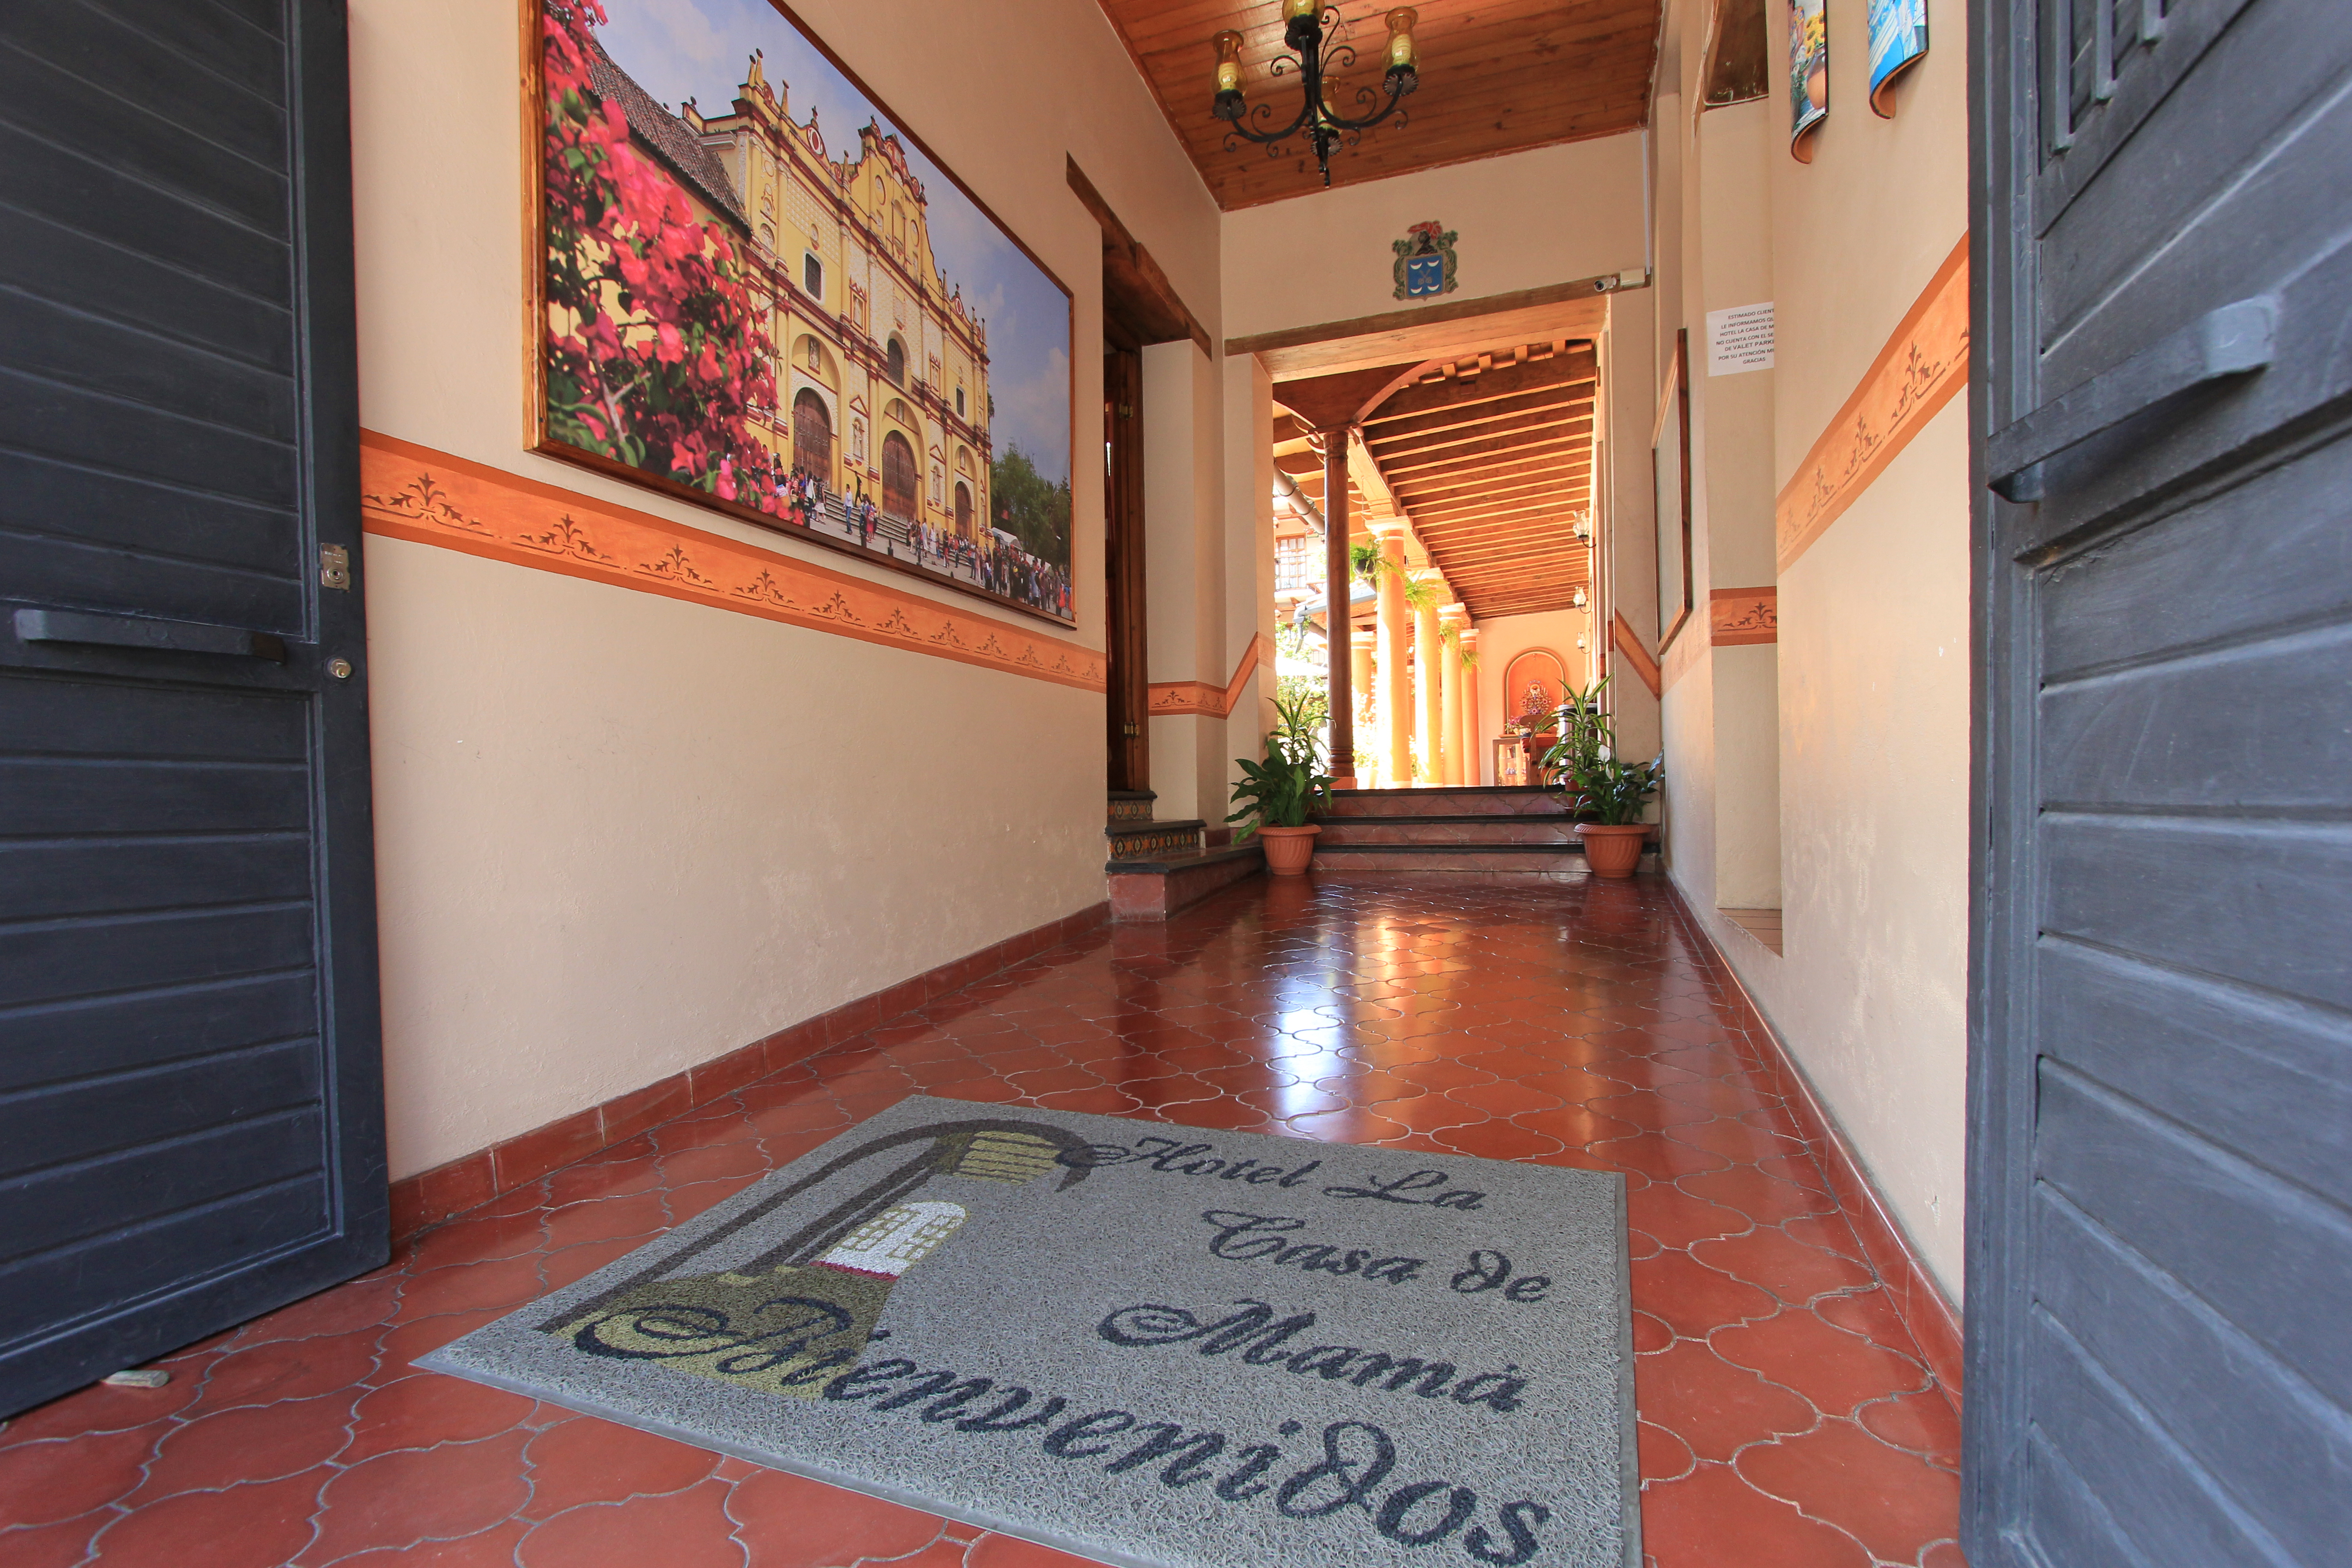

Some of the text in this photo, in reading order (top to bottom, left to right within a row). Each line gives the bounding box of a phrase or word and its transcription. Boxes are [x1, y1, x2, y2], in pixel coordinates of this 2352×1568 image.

[1728, 311, 1756, 319] ESTIMADO
[1728, 318, 1765, 328] INFORMAMOS
[1733, 342, 1753, 350] VALET
[1739, 349, 1766, 358] ATENCIÓN
[1055, 1135, 1486, 1212] Hotel La
[1201, 1210, 1553, 1303] Casa de
[573, 1296, 1551, 1567] Bienvenidos
